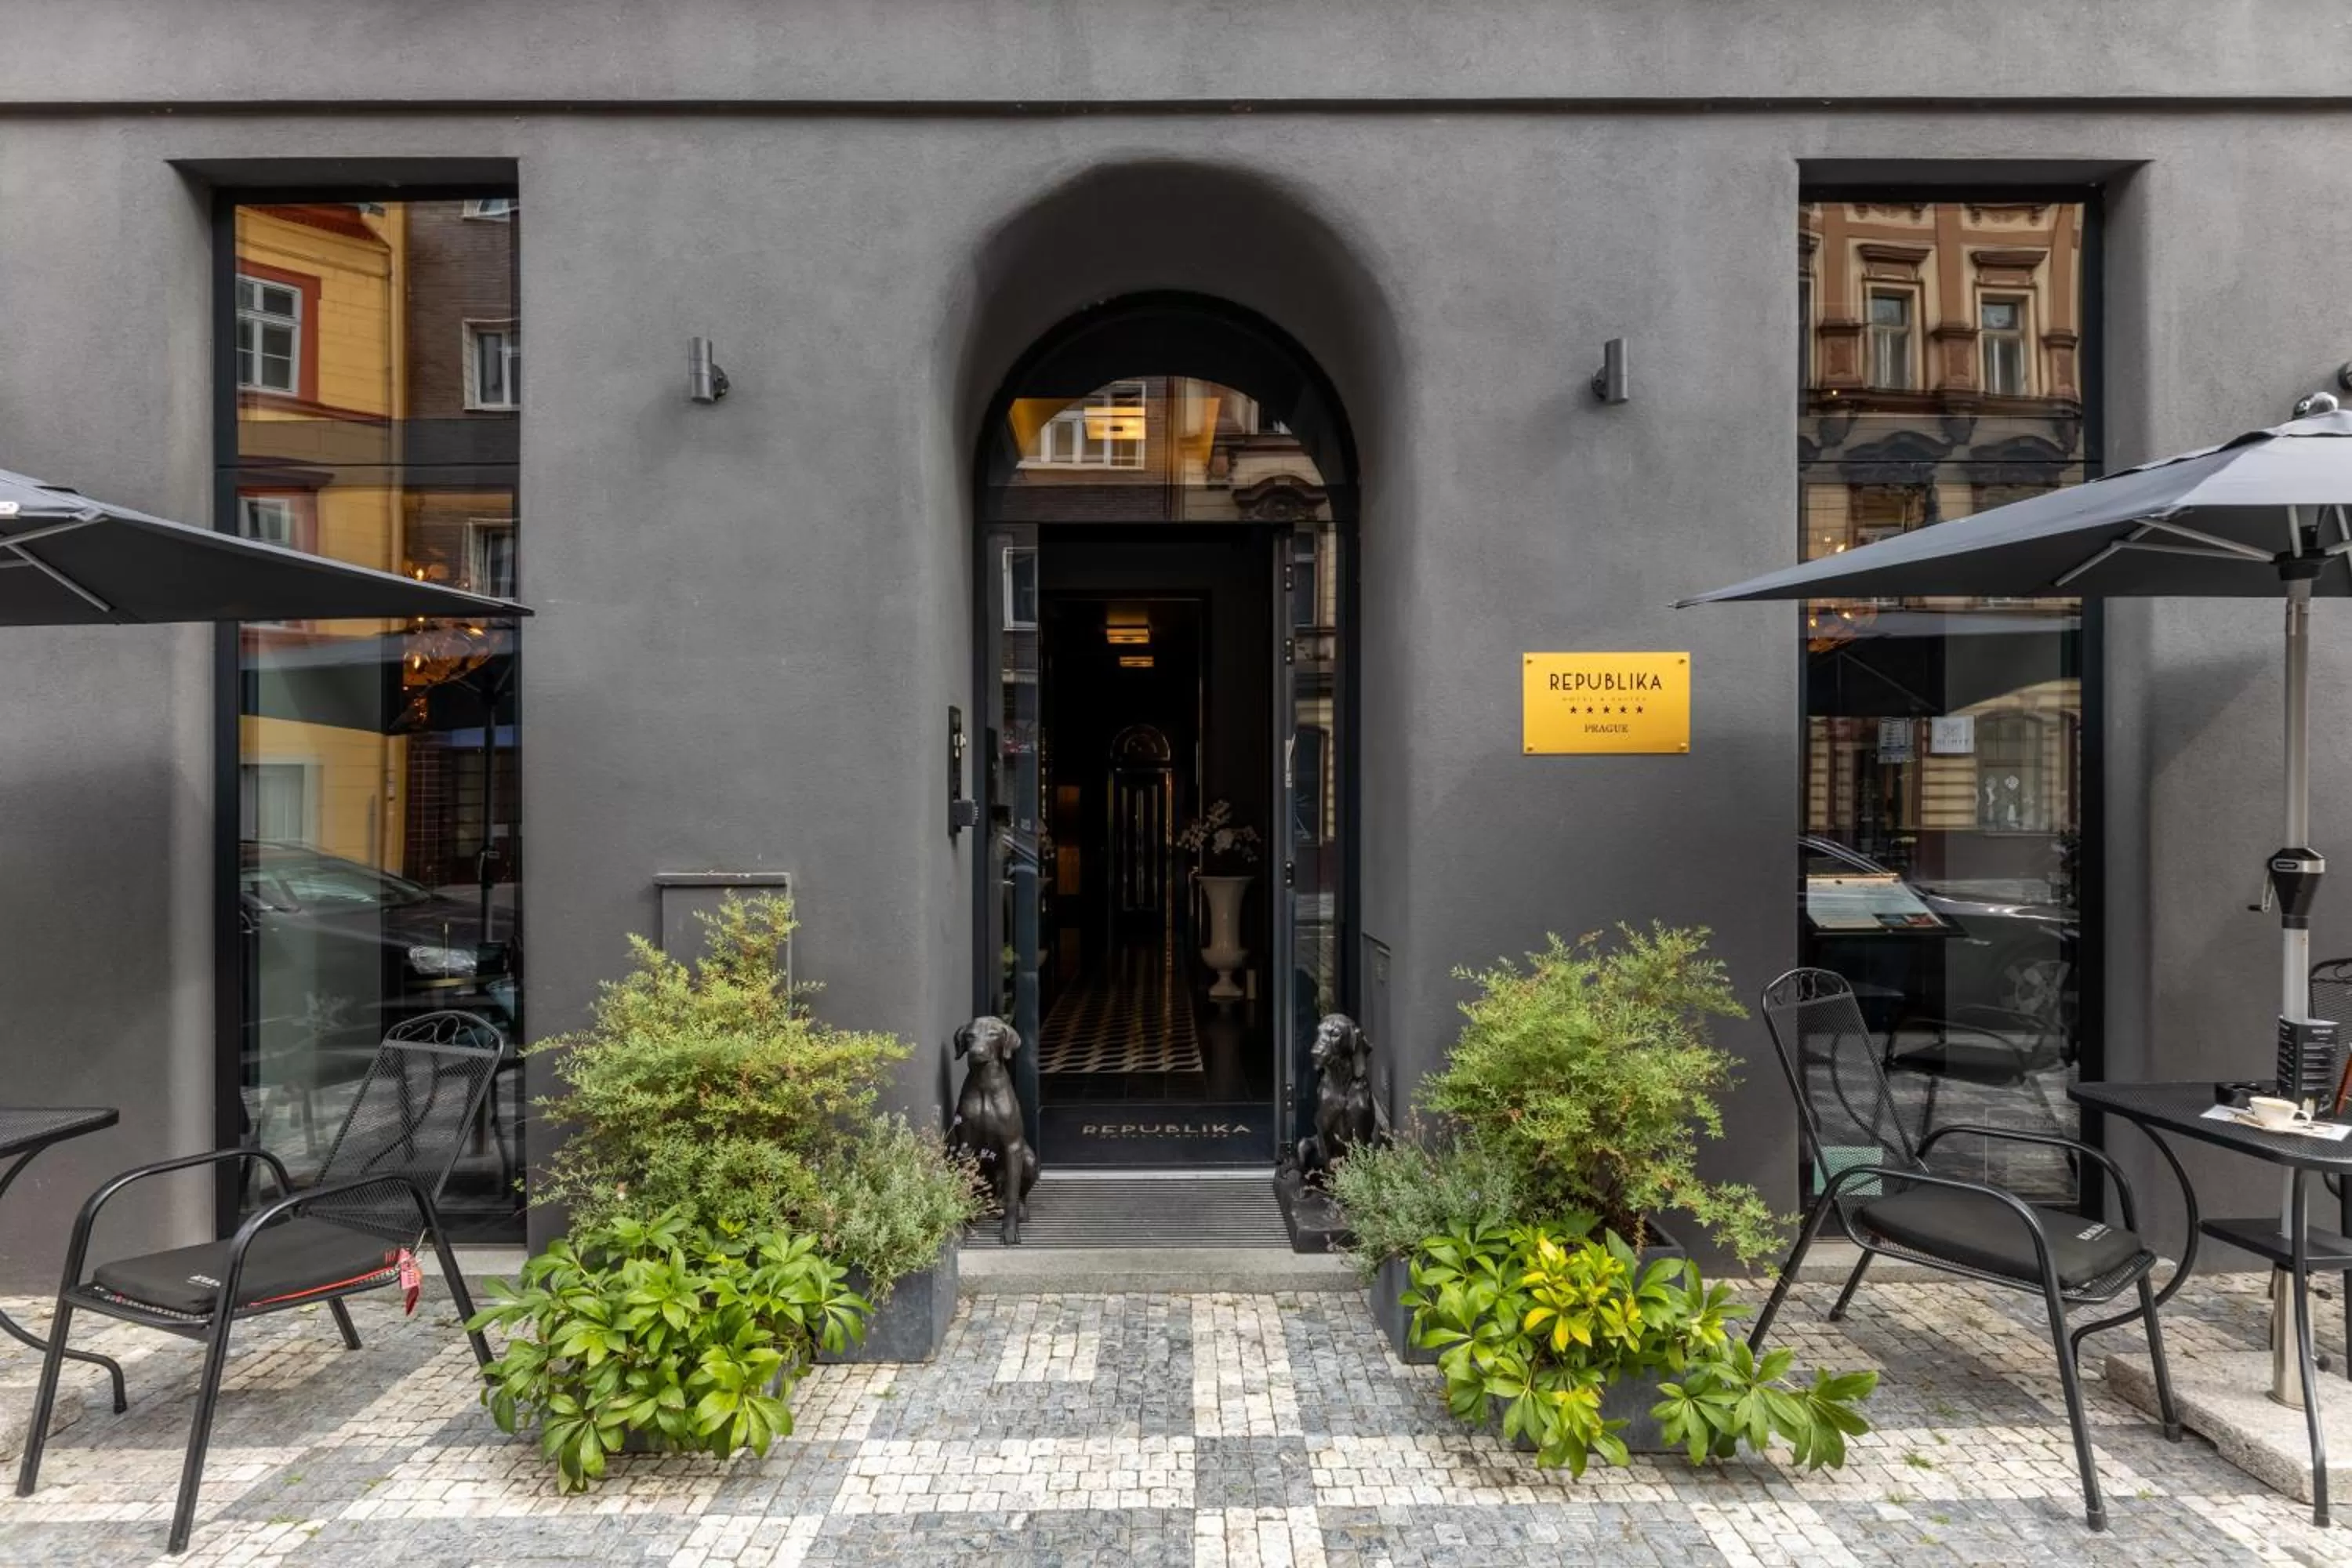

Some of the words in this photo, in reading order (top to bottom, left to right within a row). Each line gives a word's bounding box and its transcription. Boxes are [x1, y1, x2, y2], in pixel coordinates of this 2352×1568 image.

[1549, 672, 1663, 691] REPUBLIKA
[1584, 724, 1628, 733] PRAGUE
[1081, 1123, 1252, 1134] REPUBLIKA
